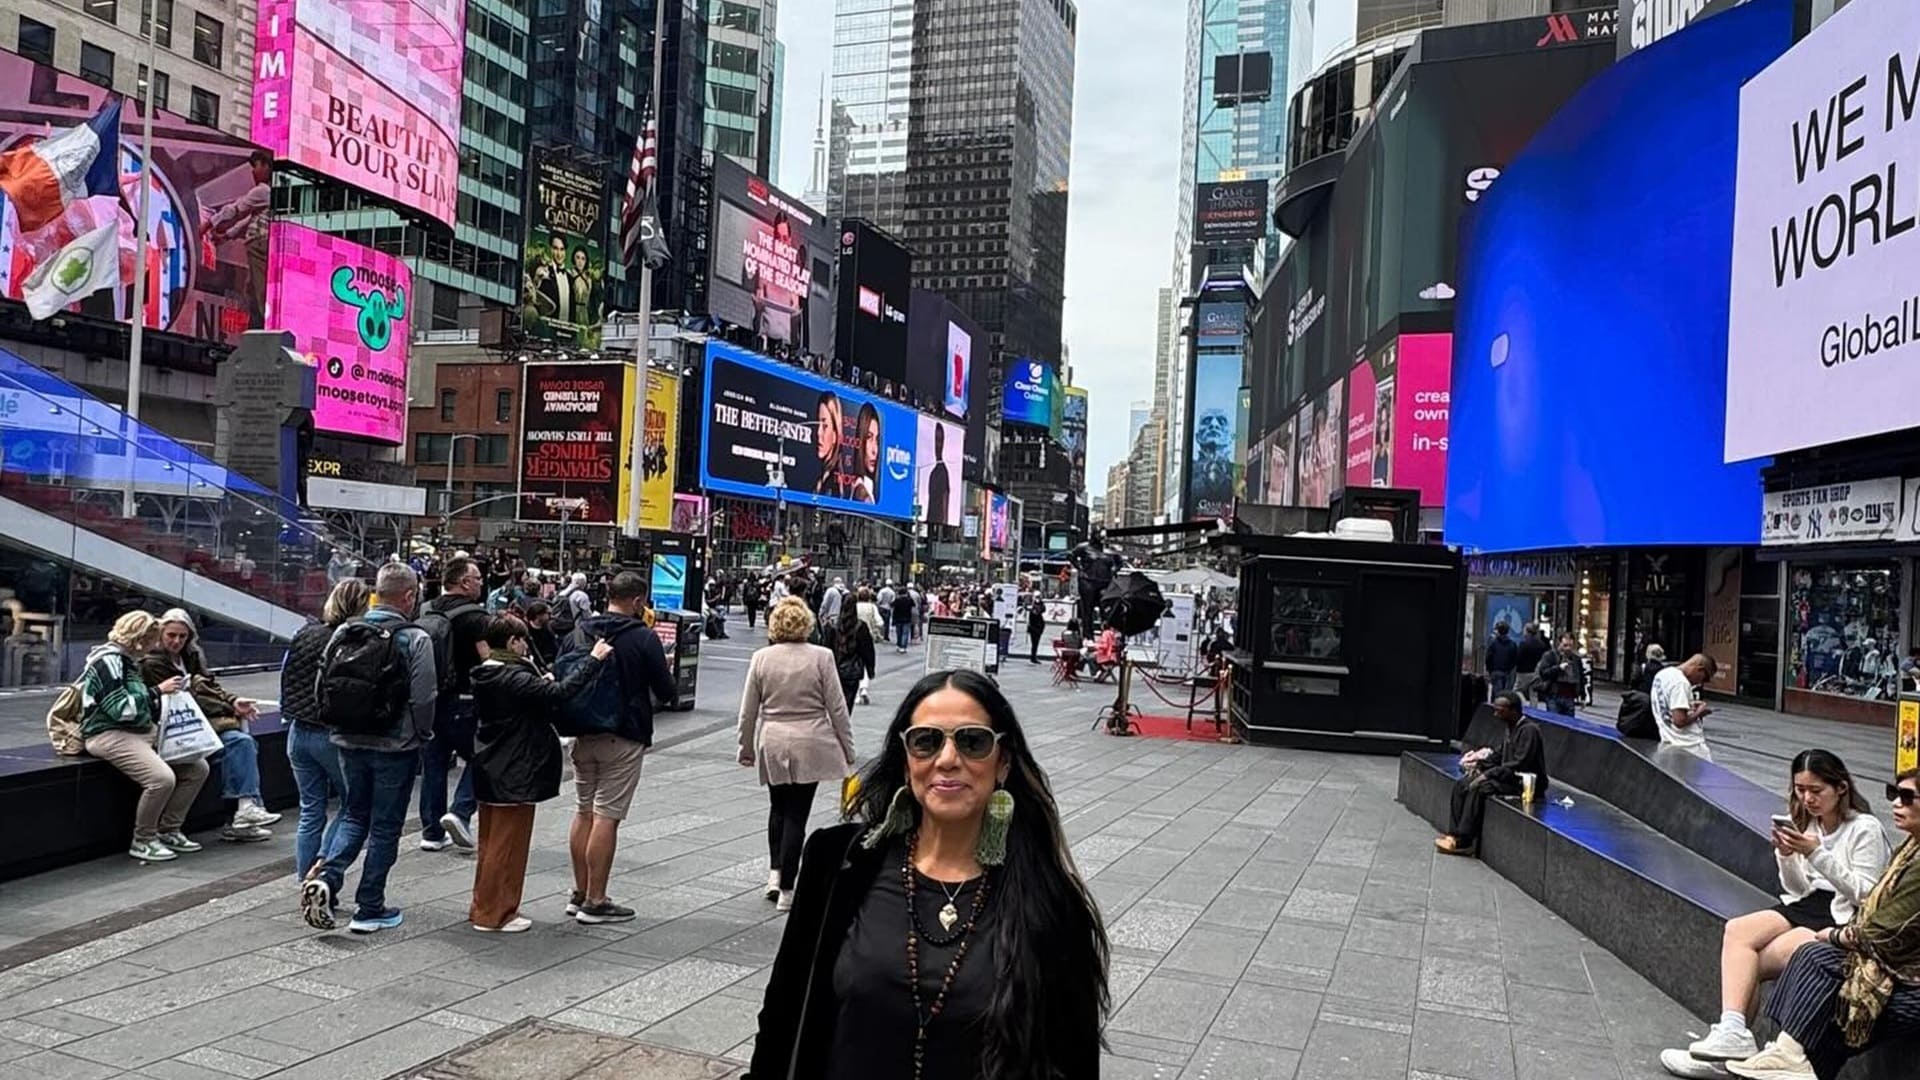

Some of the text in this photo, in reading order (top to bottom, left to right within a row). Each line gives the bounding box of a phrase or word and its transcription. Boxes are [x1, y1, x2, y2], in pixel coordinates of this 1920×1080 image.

[1793, 75, 1867, 184] WE
[325, 127, 398, 183] YOUR
[538, 184, 560, 207] THE
[562, 195, 599, 220] GREAT
[545, 207, 593, 233] GATSBY
[759, 231, 798, 262] THE MOST
[842, 247, 853, 255] LG
[743, 240, 811, 285] NOMINATED PLAY
[356, 265, 397, 292] moose
[745, 257, 808, 299] OF THE SEASON
[543, 391, 600, 401] HAS TURNED
[544, 402, 598, 412] BROADWAY
[1415, 391, 1450, 403] crea
[715, 402, 739, 427] THE
[1414, 410, 1449, 421] own
[526, 431, 613, 442] THE FIRST SHADOW
[1412, 433, 1449, 451] in-s
[539, 443, 600, 460] THINGS
[886, 444, 911, 466] prime
[526, 457, 612, 479] STRANGER
[1782, 485, 1851, 507] SPORTS FAN SHOP
